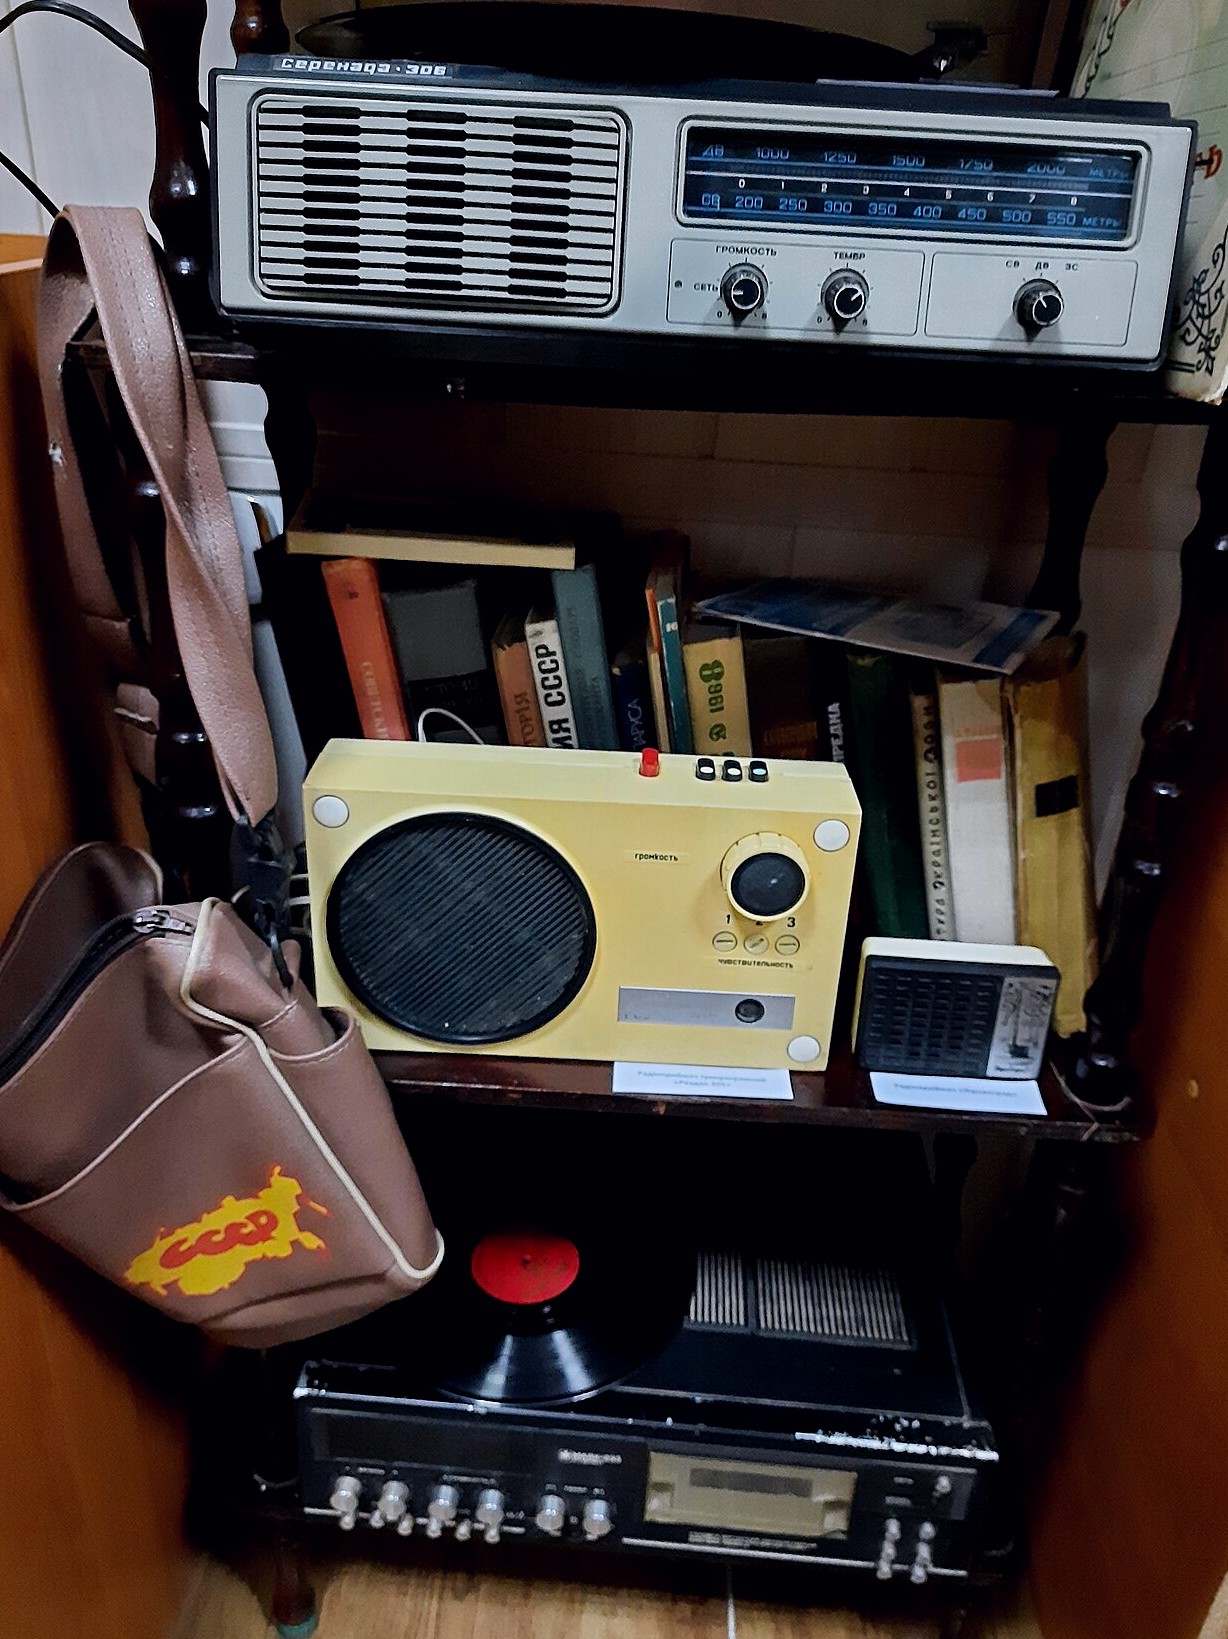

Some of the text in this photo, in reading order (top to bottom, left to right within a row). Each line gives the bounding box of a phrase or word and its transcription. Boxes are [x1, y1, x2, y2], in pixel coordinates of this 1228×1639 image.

[281, 58, 447, 76] Серенада 306
[757, 146, 790, 160] 1000
[824, 151, 857, 165] 1250
[892, 154, 925, 168] 1500
[735, 196, 764, 209] 200
[779, 198, 808, 211] 250
[823, 201, 853, 214] 300
[868, 203, 897, 216] 350
[912, 206, 942, 219] 400
[957, 208, 987, 221] 450
[1002, 210, 1032, 223] 500
[1046, 212, 1076, 226] 550
[715, 245, 777, 257] ГРОМКОСТЬ
[833, 251, 866, 261] ТЕМБР
[693, 282, 719, 292] СЕТЬ
[534, 643, 567, 708] СССР
[786, 916, 796, 928] 3
[159, 1209, 279, 1269] СССР
